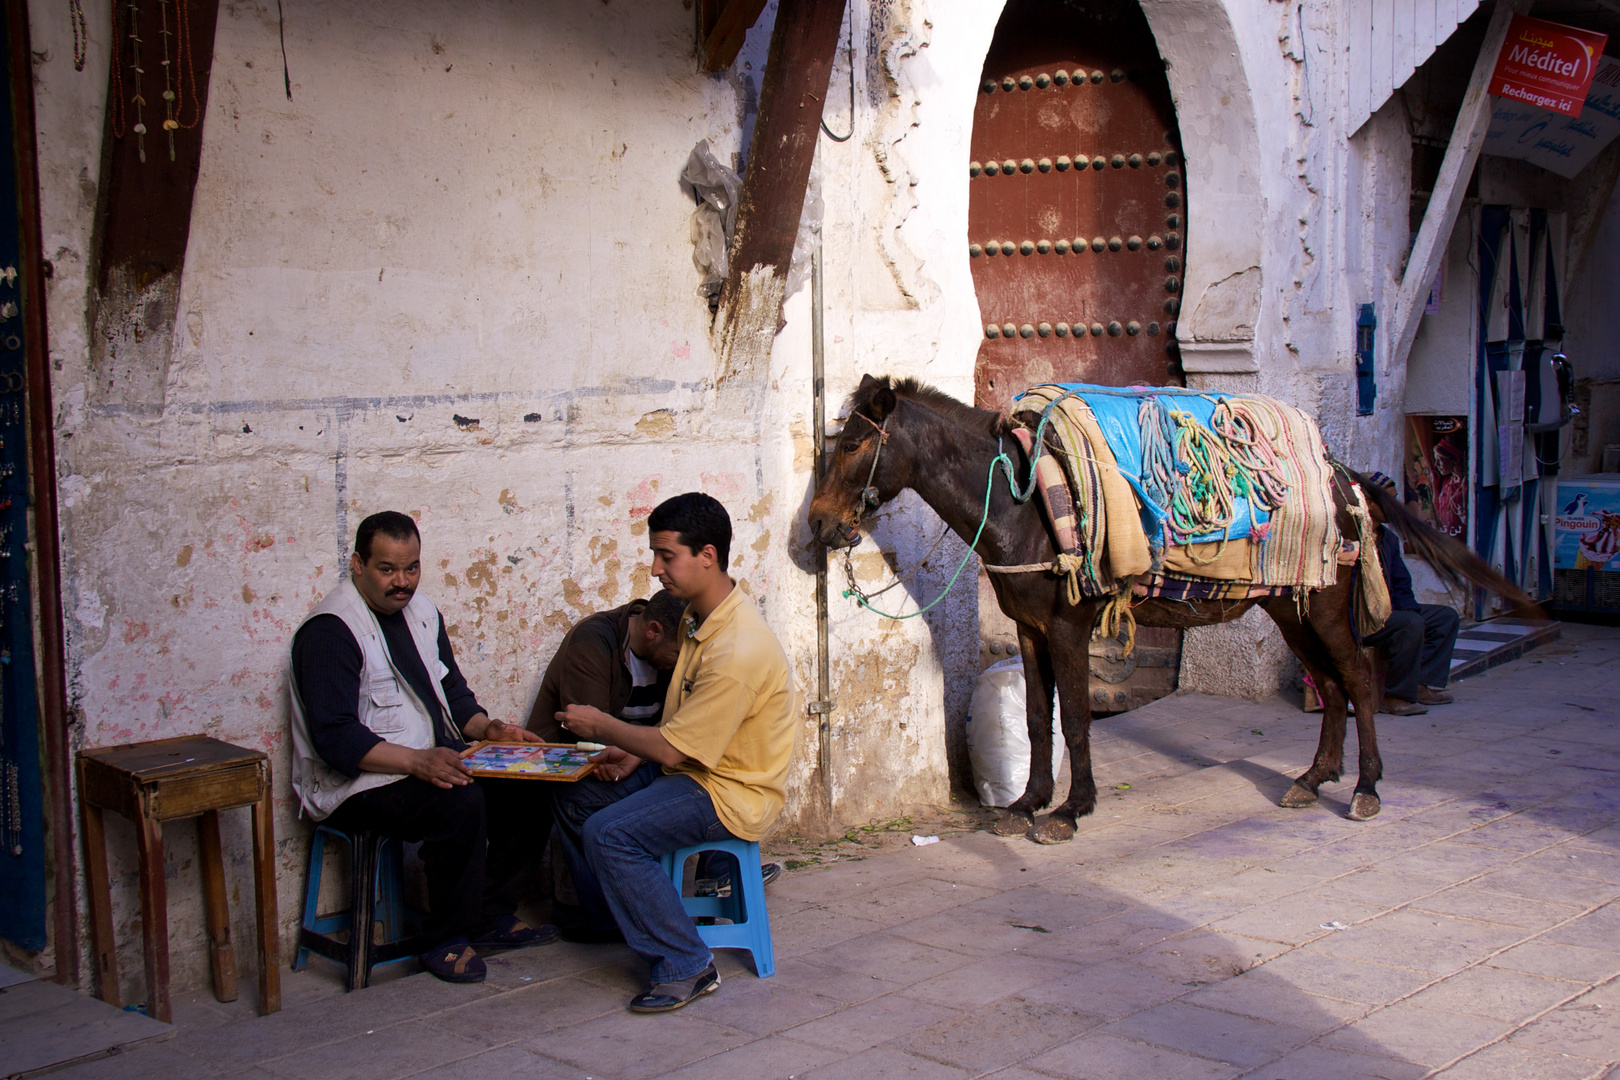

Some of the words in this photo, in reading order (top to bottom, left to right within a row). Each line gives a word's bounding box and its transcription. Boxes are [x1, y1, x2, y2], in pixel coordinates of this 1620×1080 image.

[1507, 44, 1580, 77] Méditel
[1504, 65, 1519, 74] Pour
[1519, 70, 1538, 80] mieux
[1538, 75, 1580, 91] communiquer
[1501, 83, 1557, 107] Rechargez
[1558, 98, 1572, 111] ici
[1555, 518, 1598, 529] Pingouin
